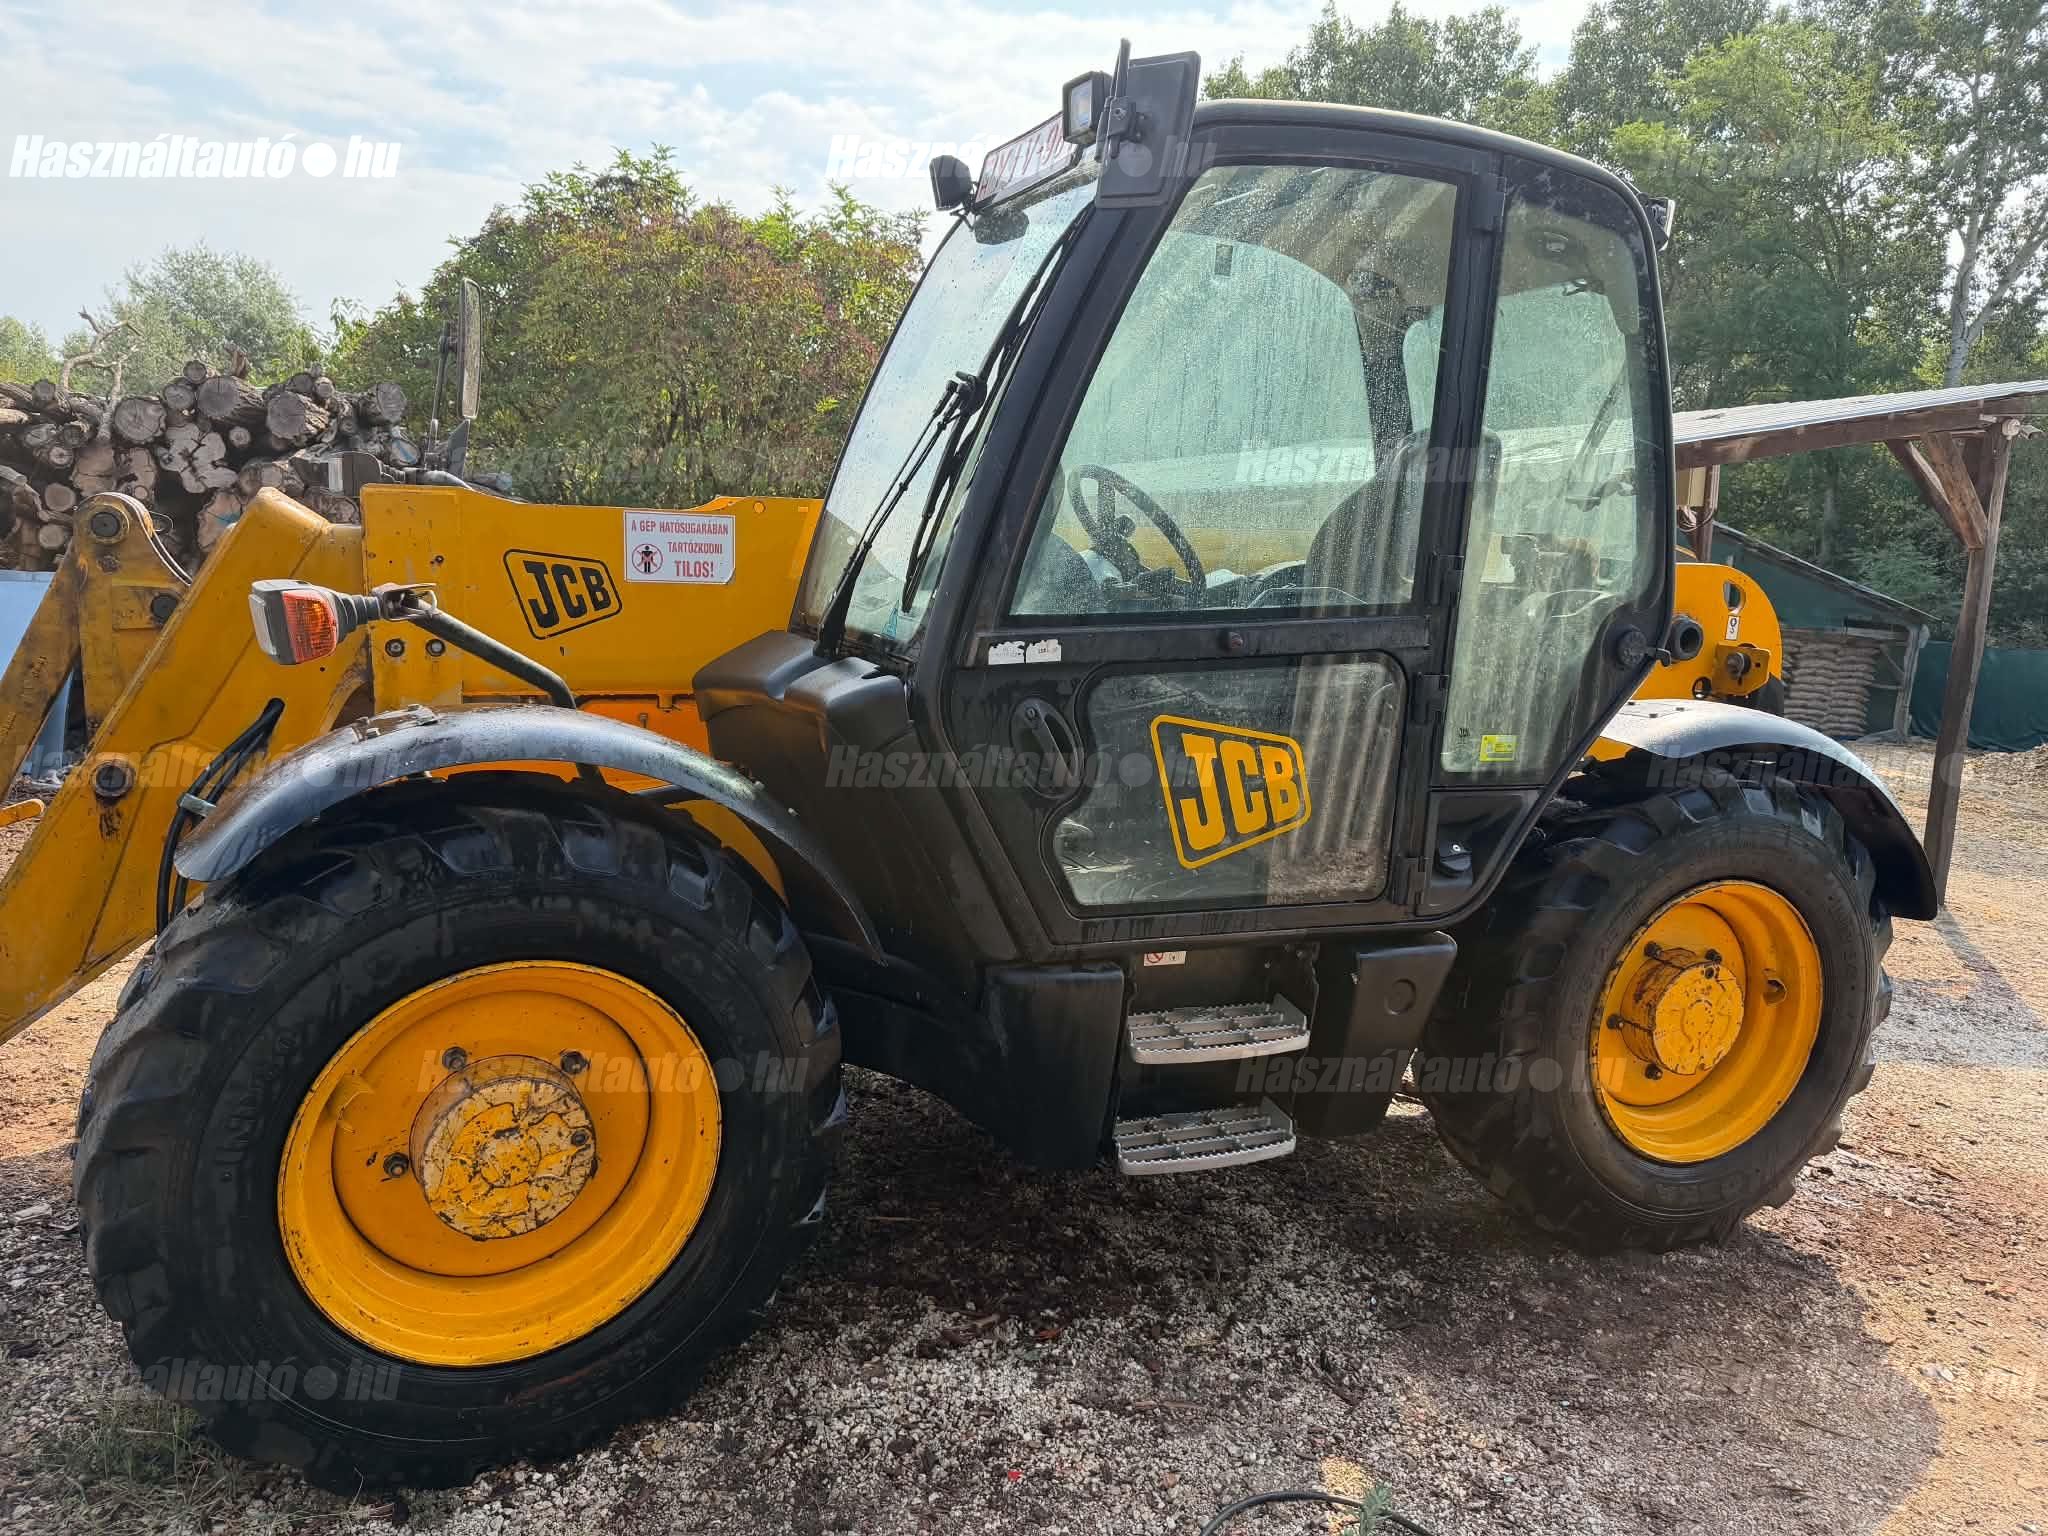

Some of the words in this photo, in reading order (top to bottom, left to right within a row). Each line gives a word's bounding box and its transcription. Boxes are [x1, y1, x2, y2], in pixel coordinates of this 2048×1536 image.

[631, 519, 637, 532] A
[674, 560, 715, 578] TILOS!
[523, 560, 611, 628] JCB
[1180, 733, 1300, 850] JCB
